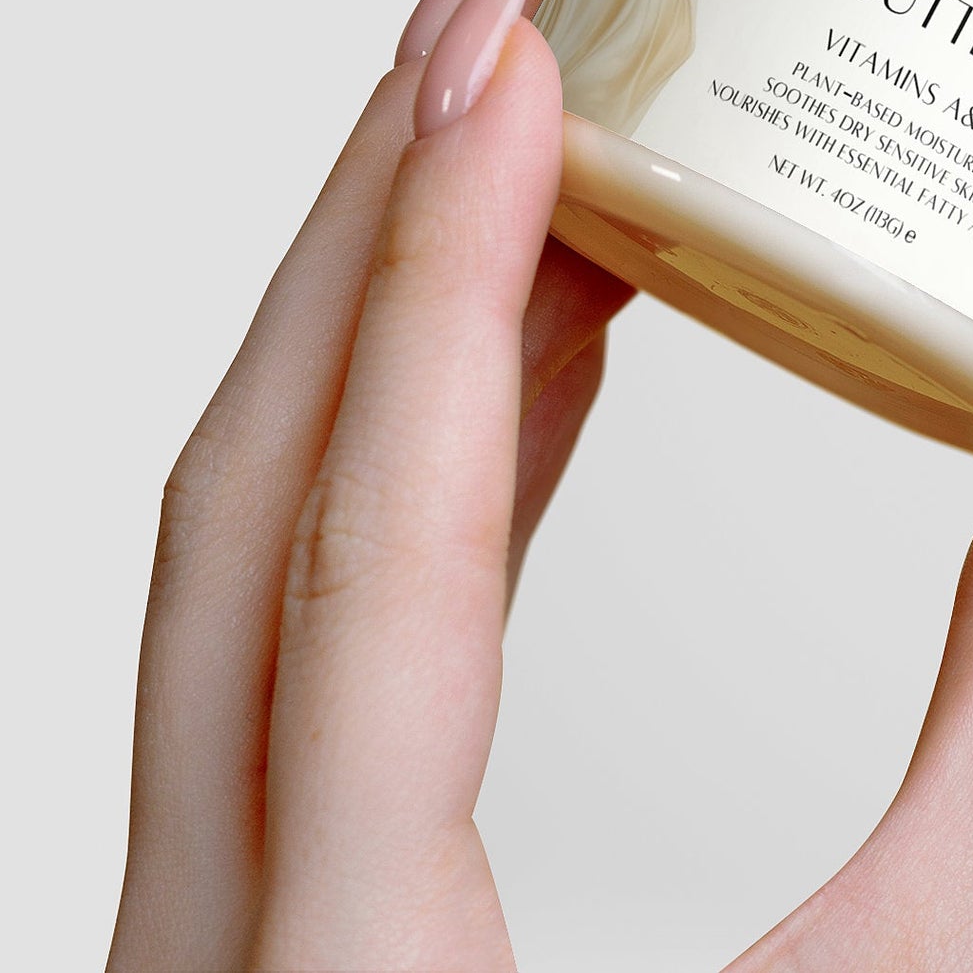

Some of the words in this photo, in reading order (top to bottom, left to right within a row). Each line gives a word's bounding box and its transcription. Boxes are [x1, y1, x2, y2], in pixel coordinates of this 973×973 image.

[792, 61, 903, 128] PLANT-BASED
[826, 28, 941, 105] VITAMINS
[708, 80, 792, 131] NOURISHES
[795, 120, 837, 153] WITH
[837, 144, 914, 197] ESSENTIAL
[917, 188, 968, 225] FATTY
[763, 77, 838, 124] SOOTHES
[838, 114, 875, 142] DRY
[875, 134, 951, 186] SENSITIVE
[768, 155, 799, 179] NET
[800, 169, 828, 197] WT.
[863, 204, 905, 239] (113G)
